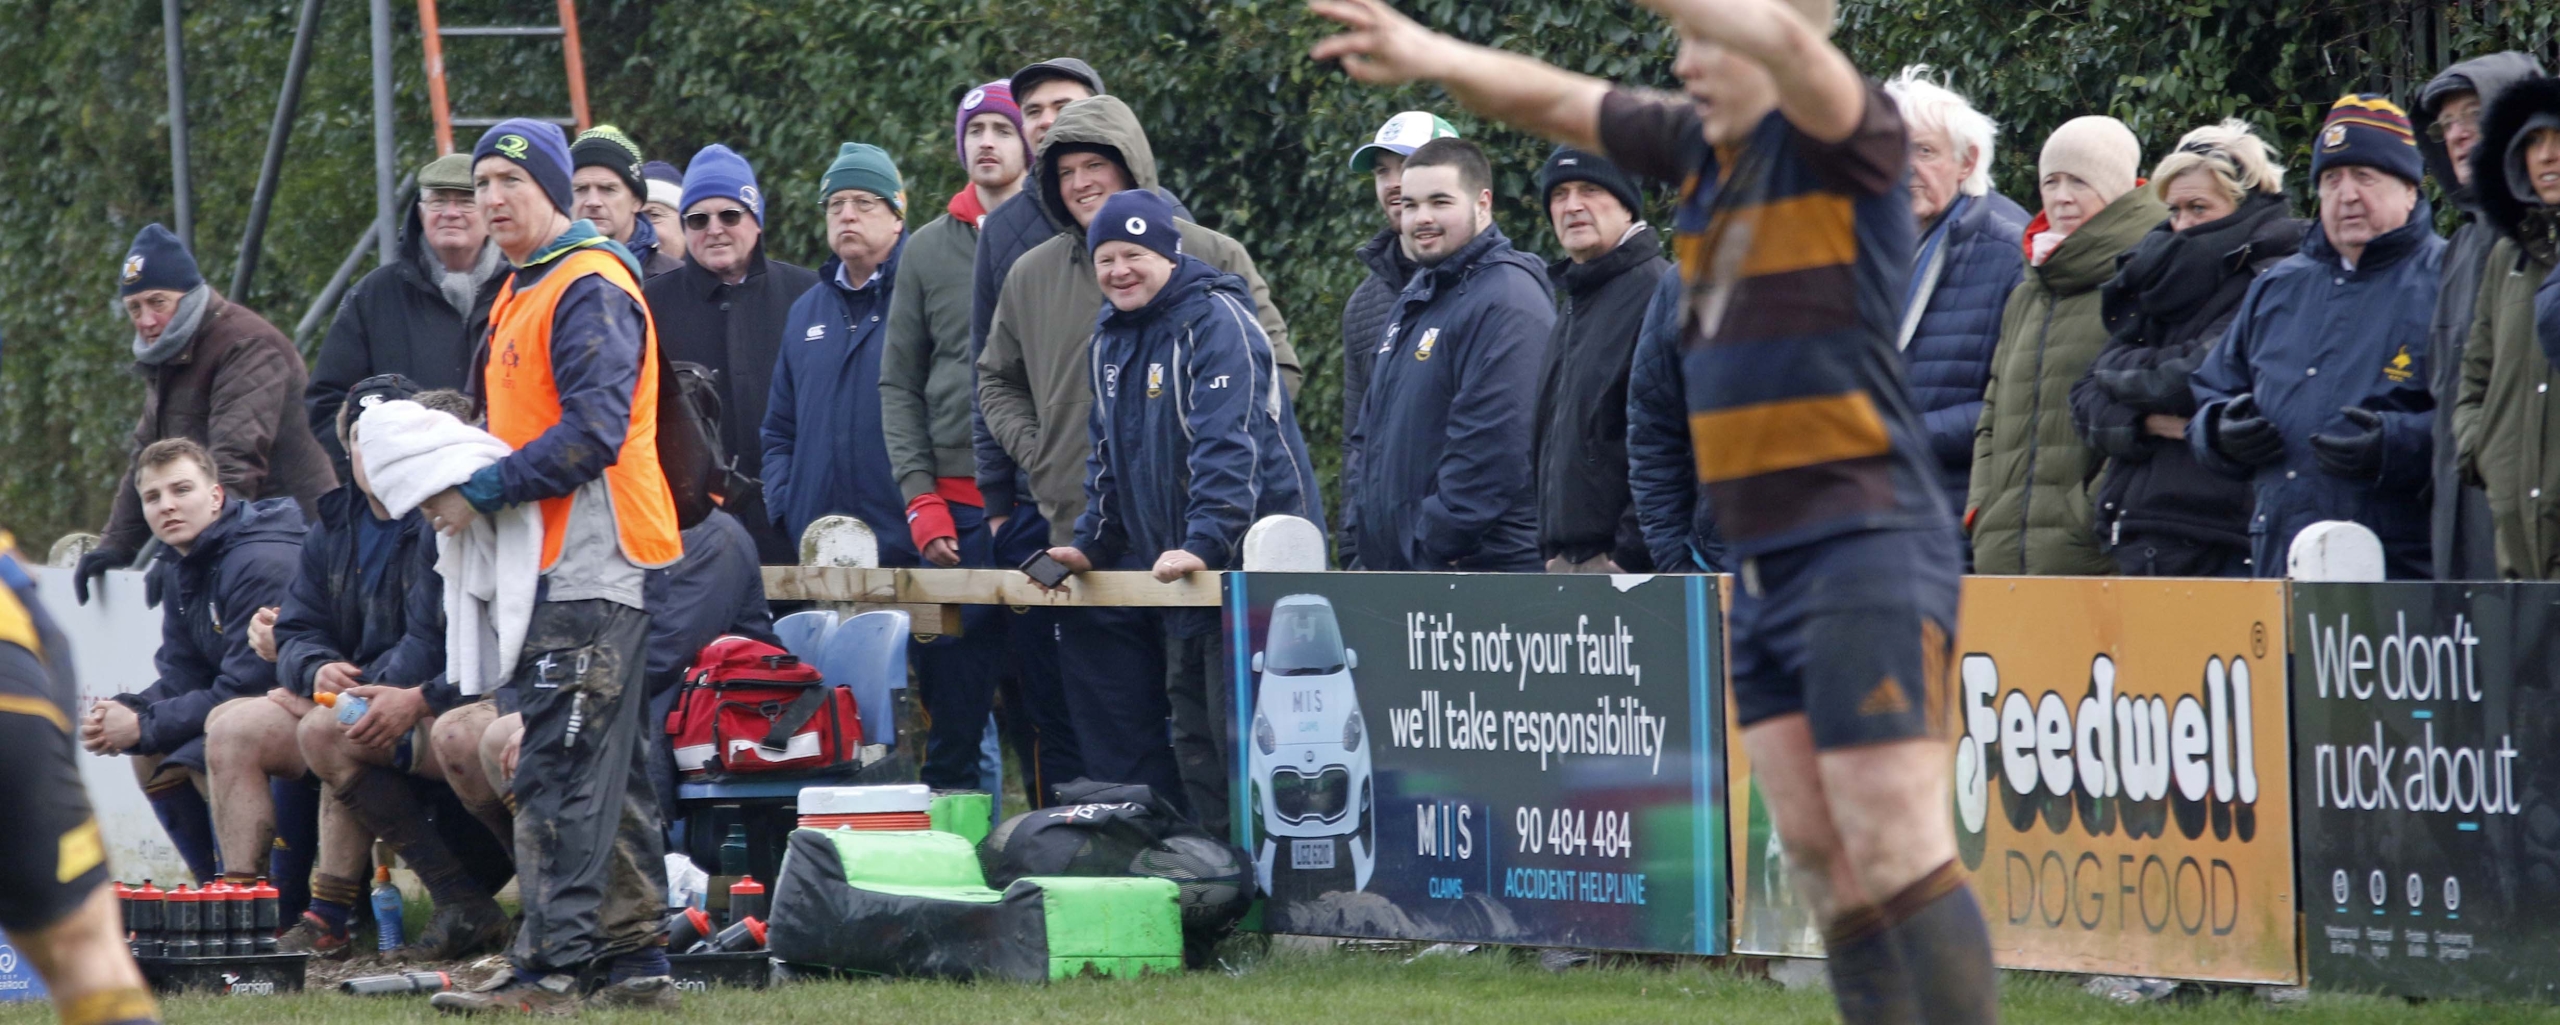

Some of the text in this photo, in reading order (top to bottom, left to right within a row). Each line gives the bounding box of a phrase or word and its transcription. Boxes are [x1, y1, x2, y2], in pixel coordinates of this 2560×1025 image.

[1209, 375, 1230, 389] JT
[1406, 611, 1641, 691] If it's not your fault,
[2308, 610, 2482, 702] We don't
[1388, 690, 1667, 776] we'll take responsibility
[1955, 652, 2258, 836] Feedwell
[2314, 720, 2522, 815] ruck about
[1516, 806, 1632, 859] 90 484 484
[1428, 876, 1464, 900] CLAIMS
[1504, 868, 1648, 905] ACCIDENT HELPLINE
[2005, 849, 2239, 937] DOG FOOD
